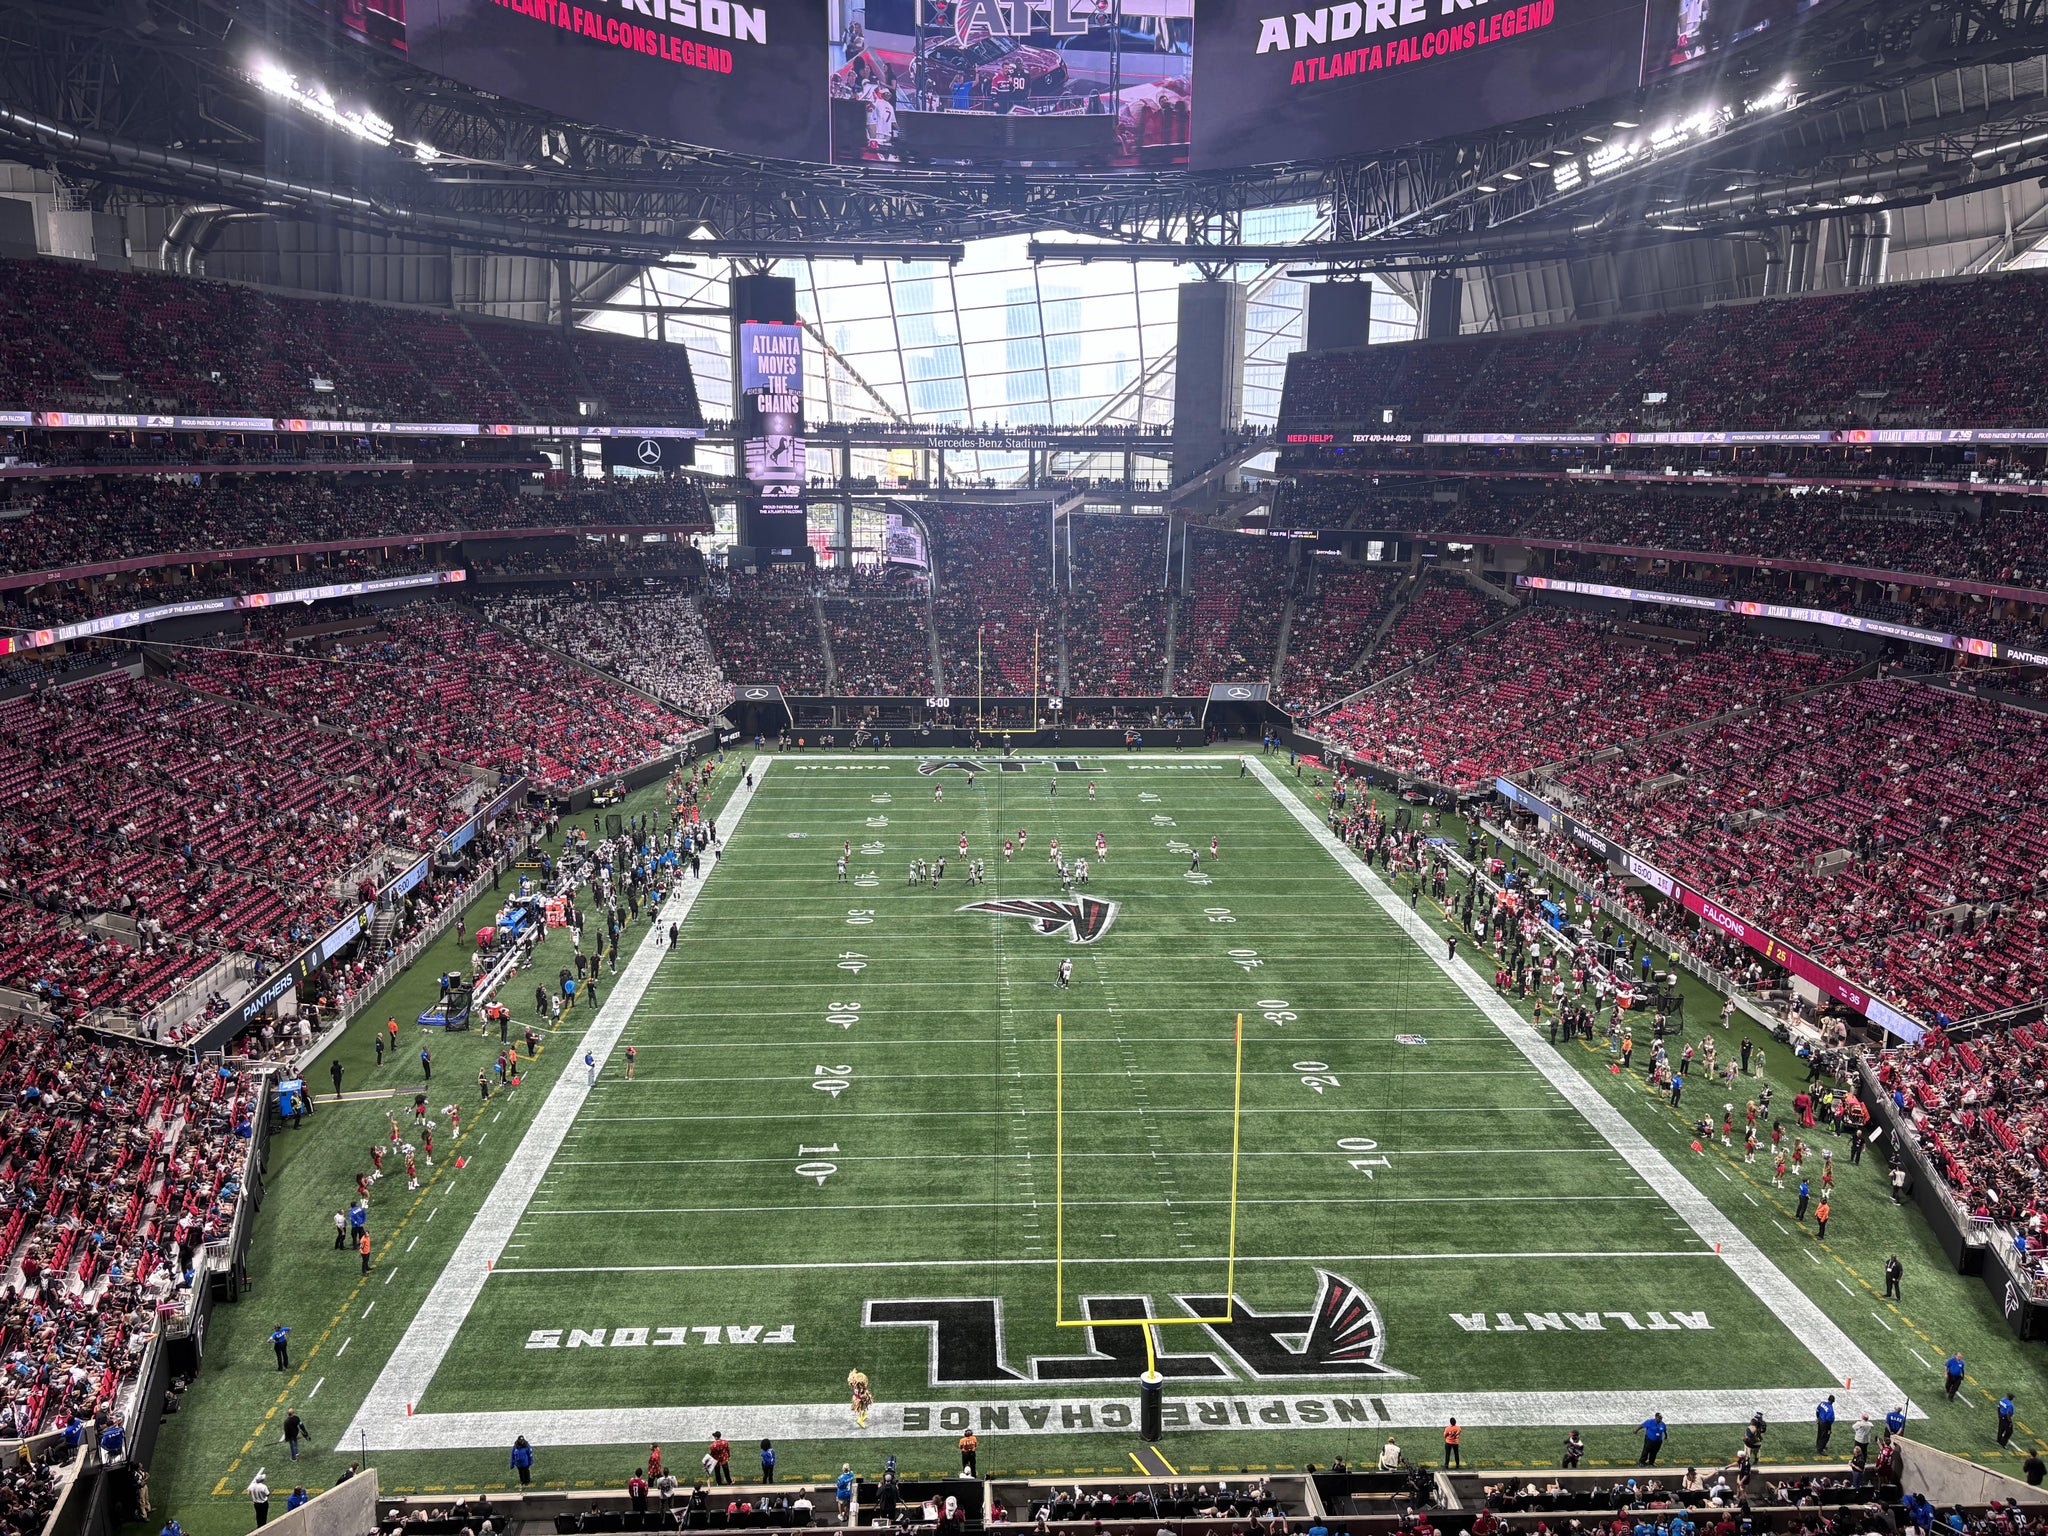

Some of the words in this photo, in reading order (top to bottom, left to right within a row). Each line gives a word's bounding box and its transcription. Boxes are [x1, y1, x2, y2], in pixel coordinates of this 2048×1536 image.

[573, 7, 658, 56] FALCONS
[660, 34, 732, 74] LEGEND
[1291, 45, 1382, 85] ATLANTA
[1386, 22, 1476, 66] FALCONS
[1479, 0, 1555, 45] LEGEND
[753, 336, 800, 355] ATLANTA
[758, 356, 797, 375] MOVES
[768, 376, 788, 394] THE
[758, 394, 799, 414] CHAINS
[928, 437, 1003, 448] Mercedes-Benz
[1006, 437, 1047, 448] Stadium
[1287, 434, 1308, 442] NEED
[1309, 434, 1334, 442] HELP?
[1353, 434, 1368, 442] TEXT
[926, 697, 950, 708] 15:00
[1049, 698, 1063, 709] 25
[1573, 826, 1607, 853] PANTHERS
[1622, 855, 1627, 867] 0
[854, 873, 880, 886] 40
[1633, 863, 1651, 881] 15:00
[1675, 887, 1680, 899] 0
[360, 913, 367, 927] 25
[846, 909, 876, 924] 50
[1203, 908, 1237, 923] 50
[1703, 904, 1745, 937] FALCONS
[311, 952, 317, 966] 0
[836, 951, 869, 969] 40
[1227, 949, 1264, 968] 40
[1776, 948, 1787, 962] 25
[243, 973, 293, 1021] PANTHERS
[1849, 993, 1860, 1006] 35
[825, 1002, 861, 1023] 30
[1256, 1000, 1298, 1021] 30
[812, 1064, 852, 1091] 20
[1292, 1061, 1341, 1087] 20
[795, 1142, 840, 1176] 10
[1336, 1137, 1393, 1170] 10
[862, 1267, 1418, 1387] ATL
[1449, 1312, 1716, 1331] ATLANTA
[525, 1325, 796, 1349] FALCONS
[903, 1403, 1134, 1431] CHANCE
[1163, 1399, 1390, 1429] INSPIRE
[2013, 1514, 2027, 1529] 99
